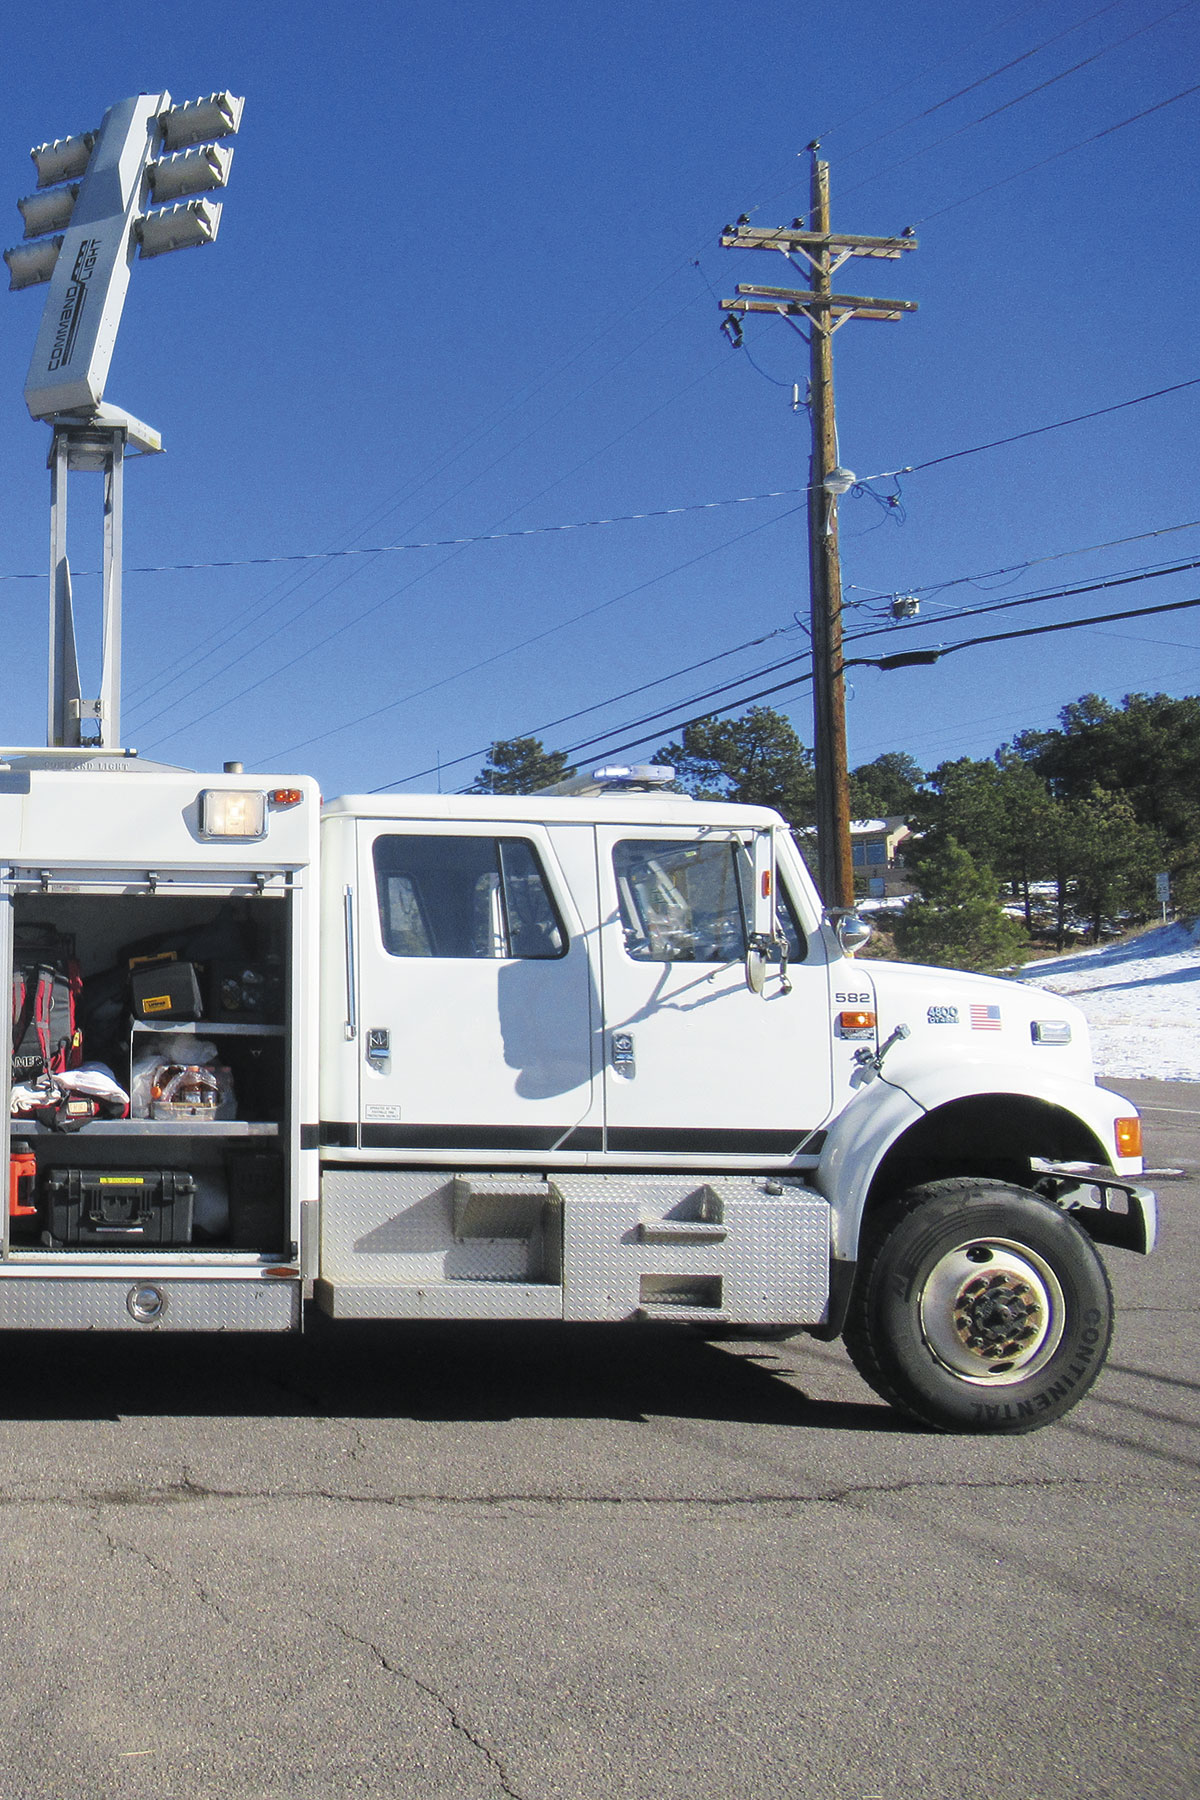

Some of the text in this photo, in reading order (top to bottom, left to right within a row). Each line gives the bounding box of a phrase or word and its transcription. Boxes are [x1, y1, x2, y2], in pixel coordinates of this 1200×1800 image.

[47, 239, 102, 372] COMMAND LIGHT
[835, 993, 870, 1003] 582
[927, 1006, 959, 1018] 4800
[970, 1308, 1101, 1421] CONTINENTAL
